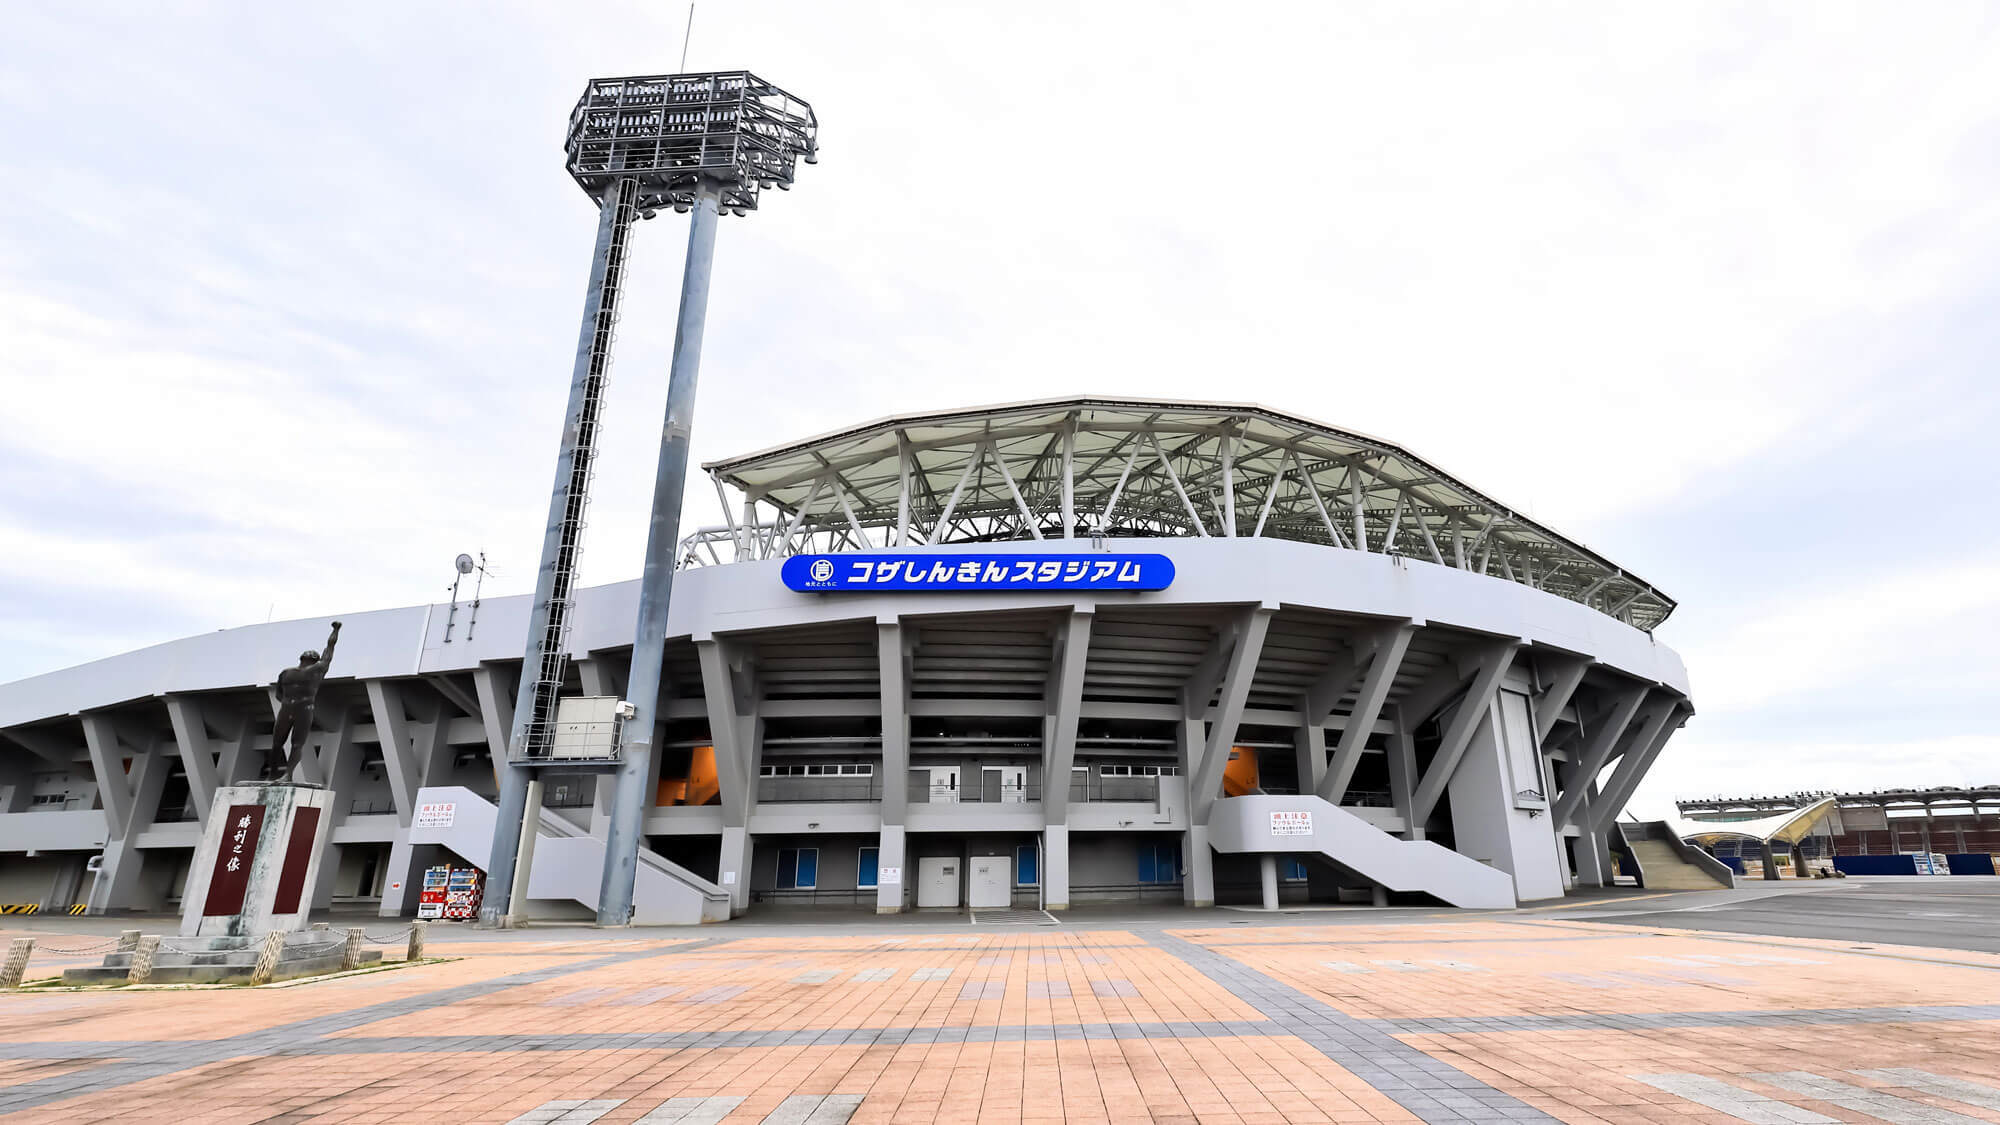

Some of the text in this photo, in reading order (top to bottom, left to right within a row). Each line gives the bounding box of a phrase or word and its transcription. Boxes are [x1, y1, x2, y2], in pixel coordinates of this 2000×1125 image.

[847, 561, 1141, 583] コザしんきんスタジアム
[226, 813, 253, 873] 勝利之像
